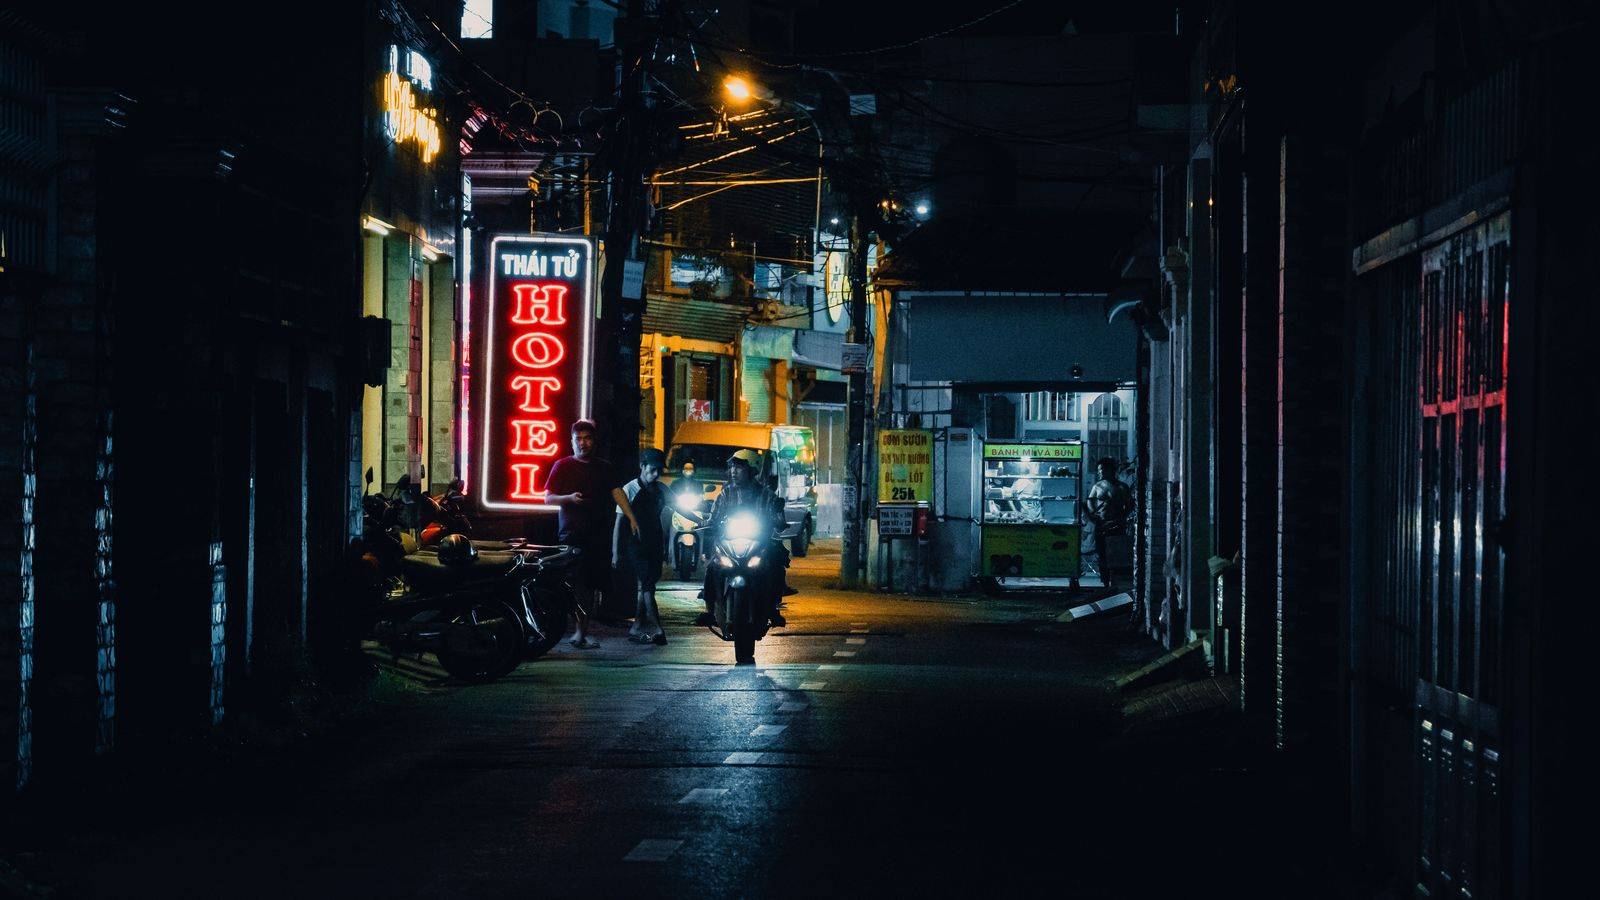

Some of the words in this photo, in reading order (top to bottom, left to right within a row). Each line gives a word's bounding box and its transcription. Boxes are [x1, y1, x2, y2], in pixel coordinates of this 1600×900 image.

[501, 250, 547, 276] THÁI
[551, 249, 580, 278] TỬ
[511, 284, 568, 499] HOTEL
[991, 446, 1019, 456] BÁNH
